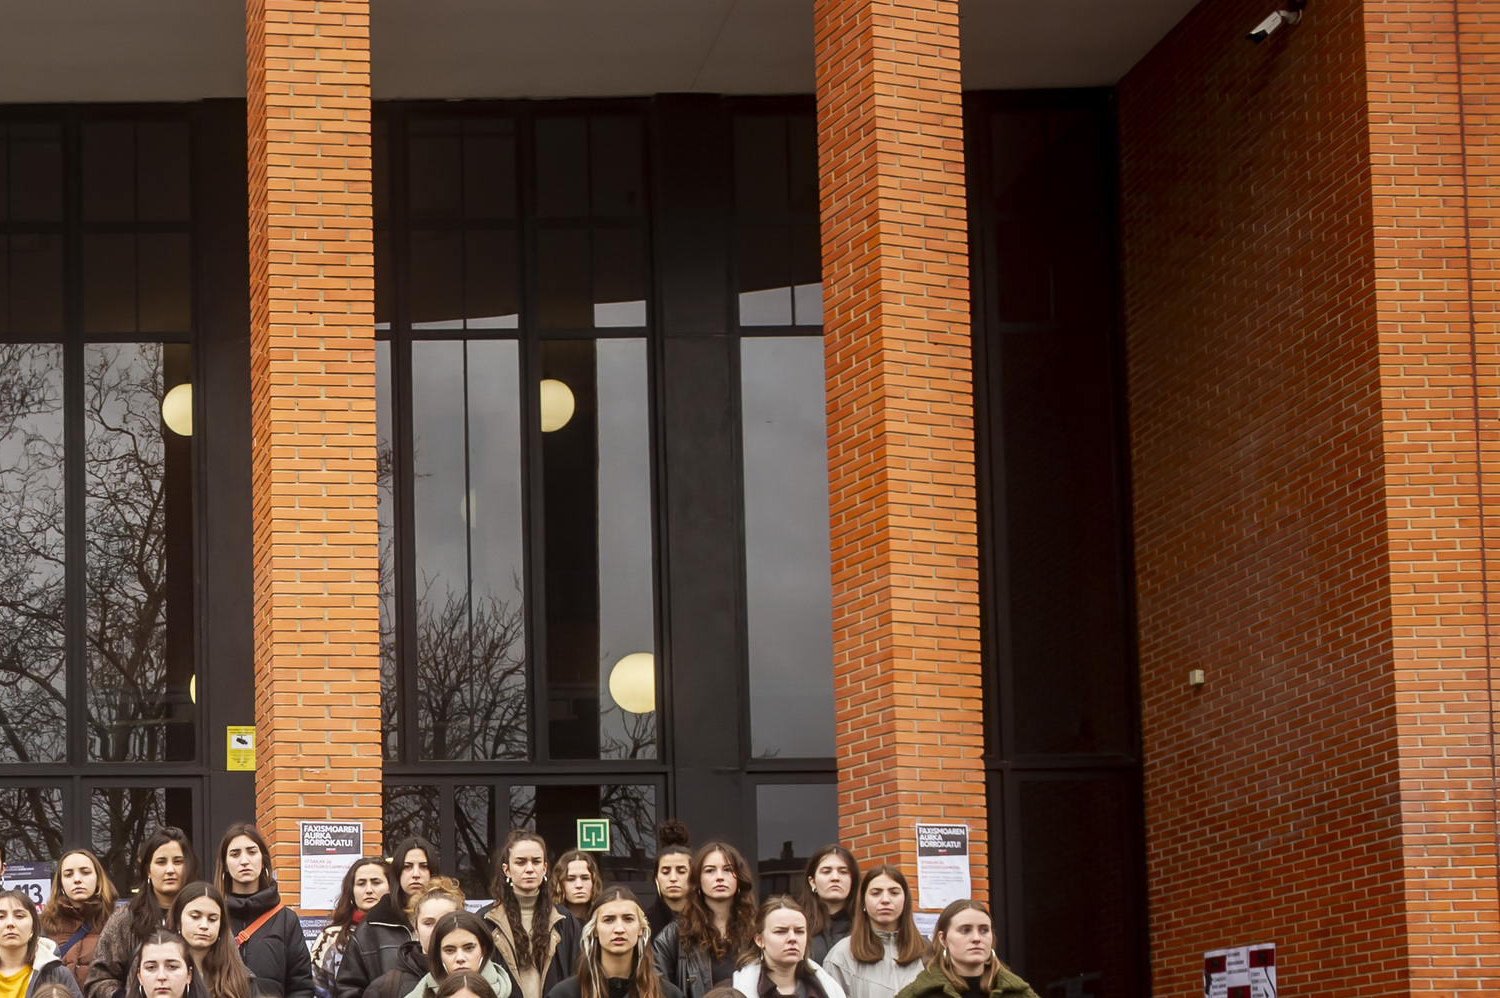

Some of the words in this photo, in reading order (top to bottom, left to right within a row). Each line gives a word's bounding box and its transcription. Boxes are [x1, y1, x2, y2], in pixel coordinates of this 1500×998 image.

[303, 825, 359, 834] FAXISMOAREN
[918, 827, 966, 836] FAXISMOAREN
[303, 832, 332, 840] AURKA
[303, 838, 354, 847] BORROKATU!
[919, 840, 962, 849] BORROKATU!
